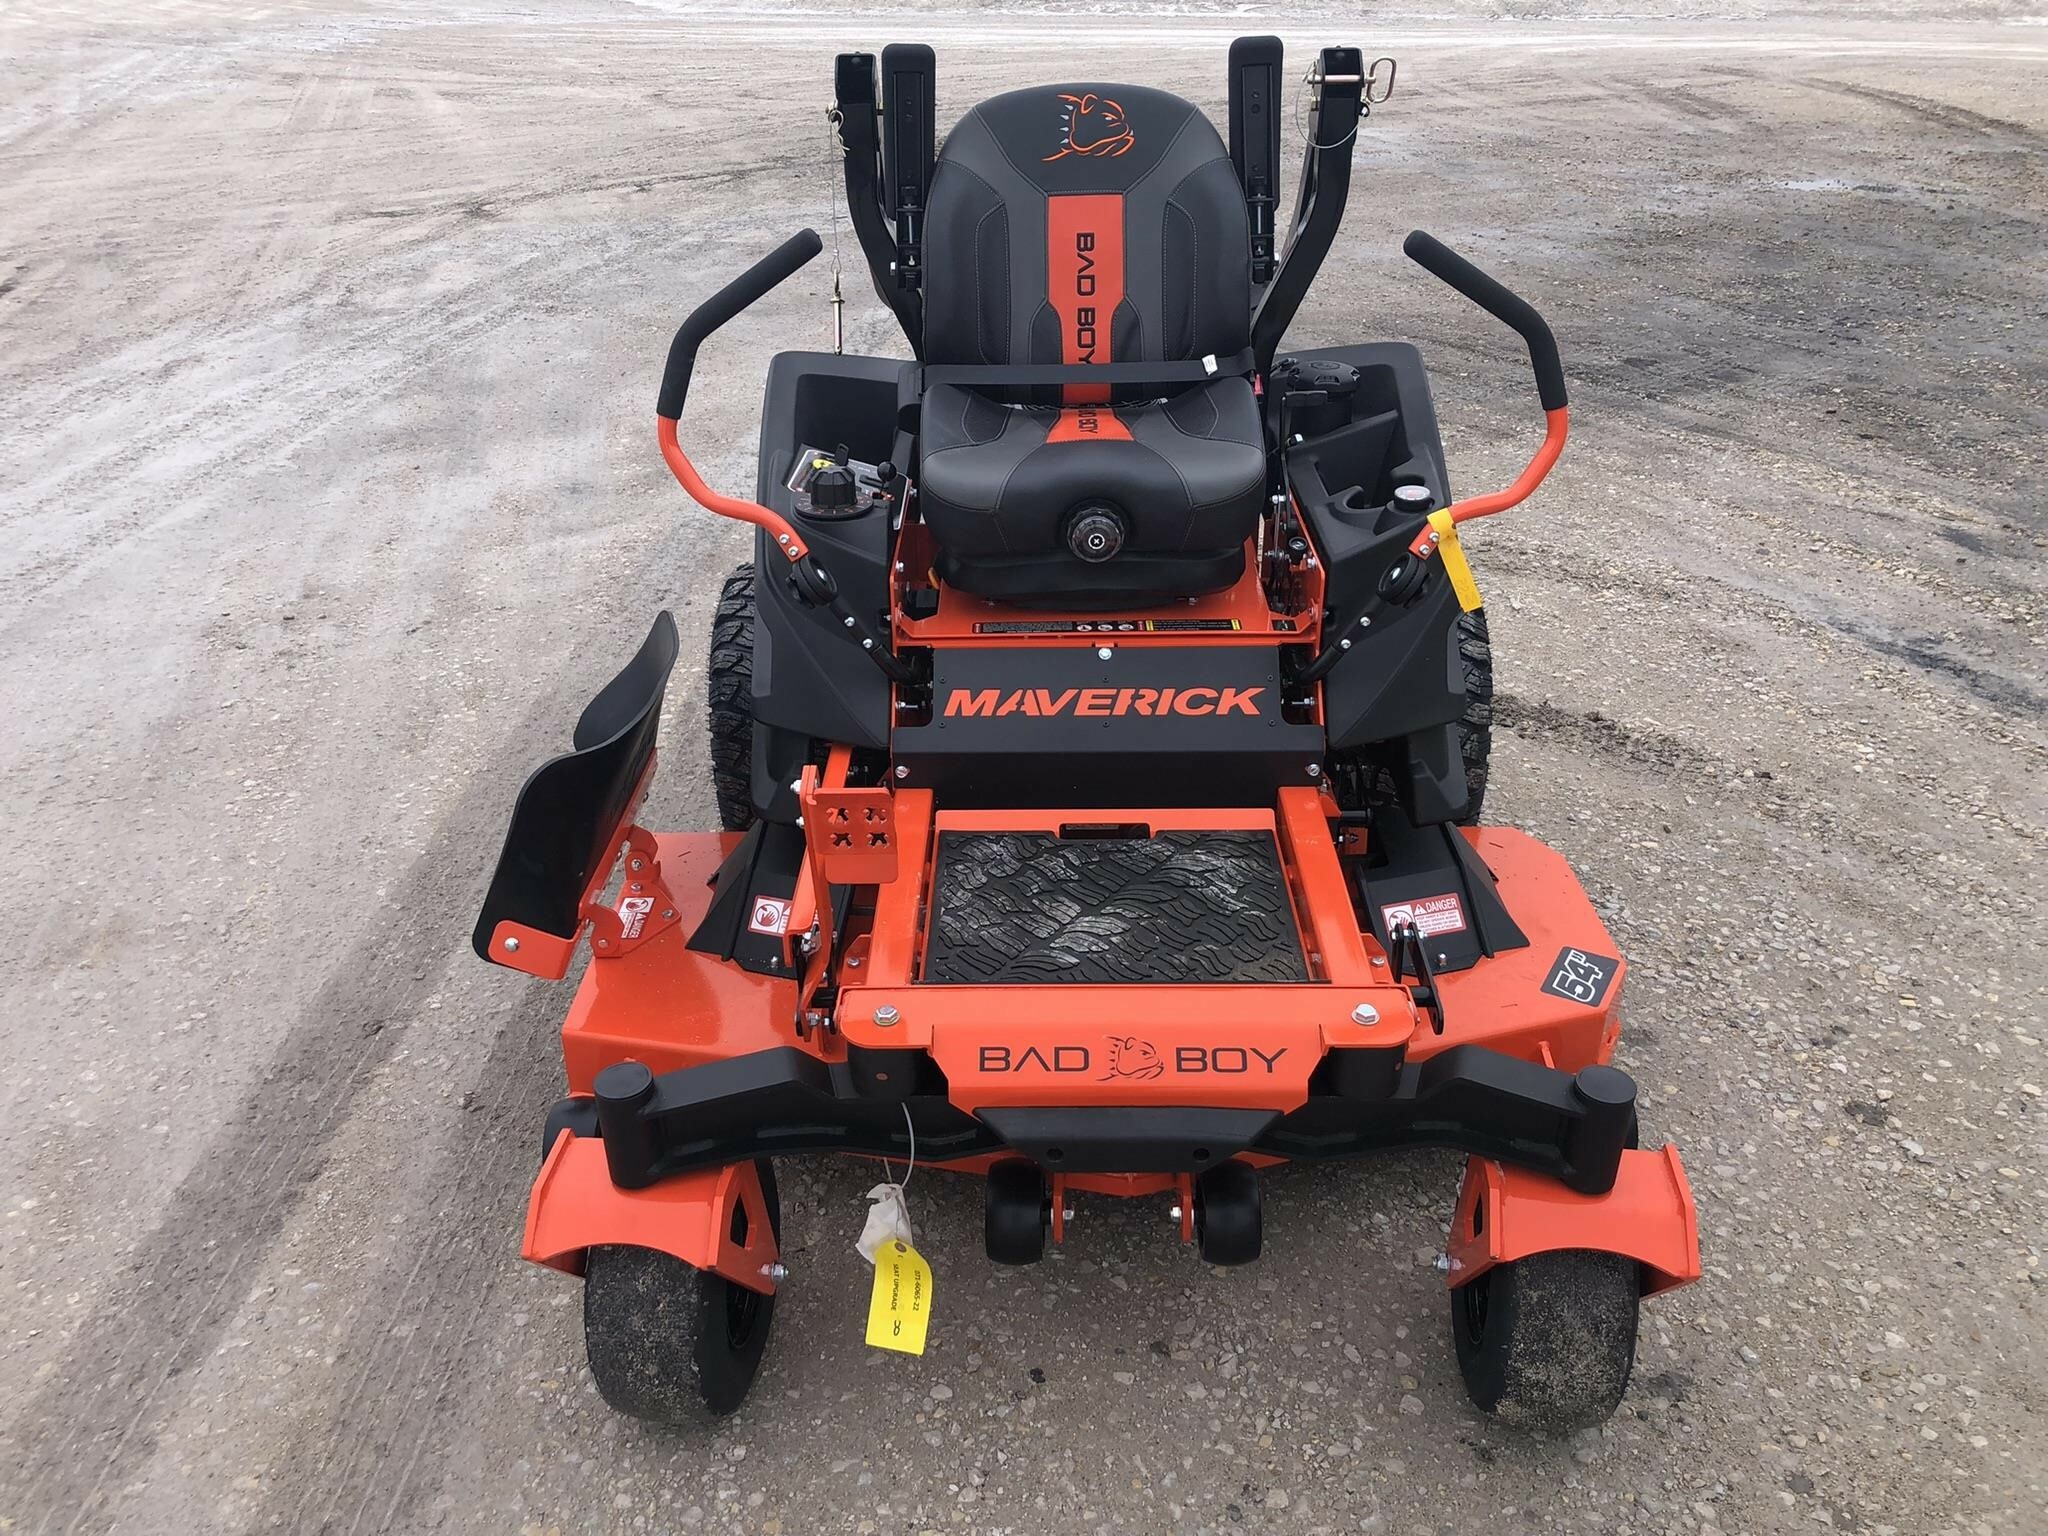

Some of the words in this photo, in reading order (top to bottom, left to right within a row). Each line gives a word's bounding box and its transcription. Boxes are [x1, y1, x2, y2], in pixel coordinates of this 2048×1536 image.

[1077, 233, 1095, 296] BAD
[944, 688, 1266, 716] MAVERICK
[1425, 898, 1458, 913] DANGER
[979, 1046, 1089, 1072] BAD
[1176, 1047, 1288, 1073] BOY
[891, 1278, 900, 1311] UPGRADE
